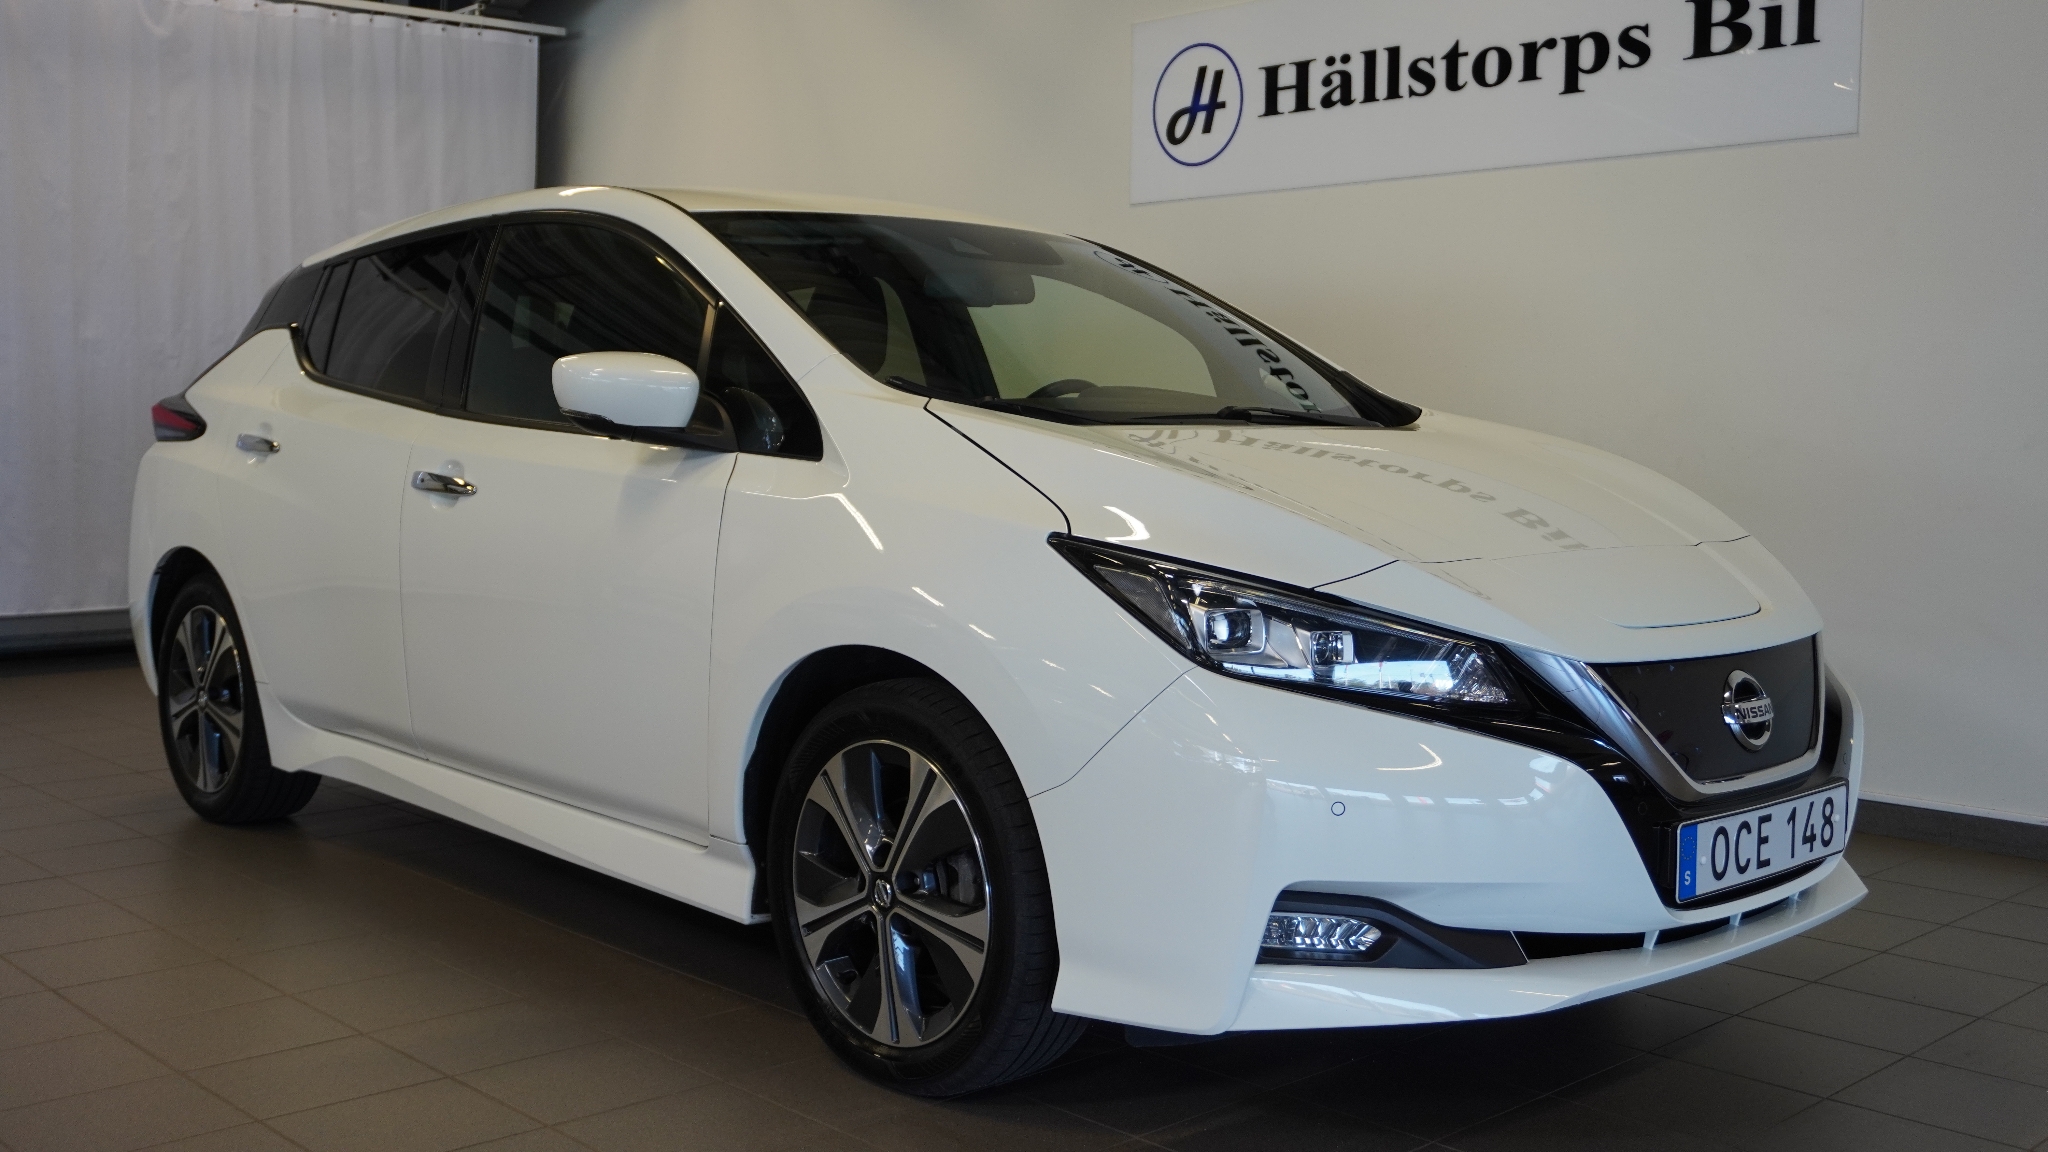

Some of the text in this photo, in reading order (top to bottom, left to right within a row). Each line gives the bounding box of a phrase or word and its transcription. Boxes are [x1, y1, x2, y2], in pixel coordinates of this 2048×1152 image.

[1257, 0, 1821, 118] Hällstorps Bil
[1736, 703, 1772, 719] NISSAN
[1711, 797, 1834, 880] OCE 148
[1684, 870, 1692, 885] S
